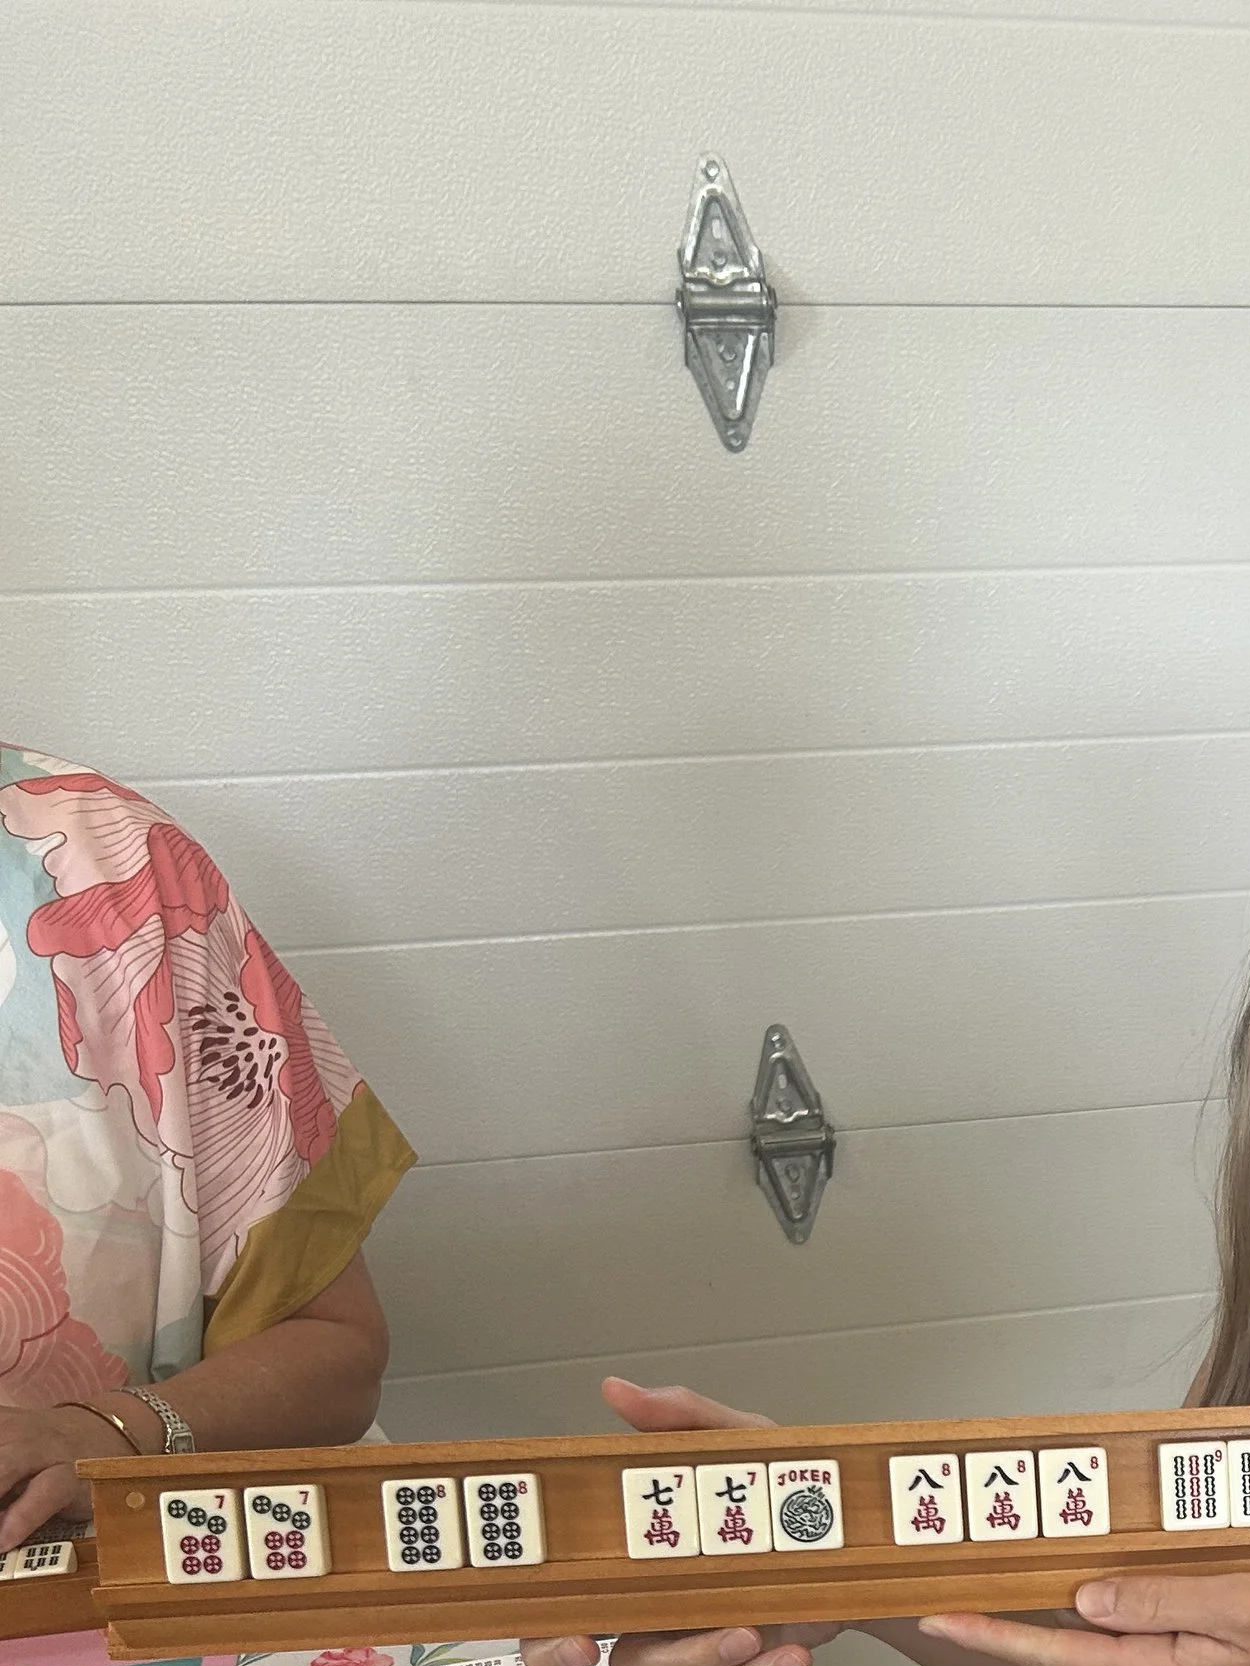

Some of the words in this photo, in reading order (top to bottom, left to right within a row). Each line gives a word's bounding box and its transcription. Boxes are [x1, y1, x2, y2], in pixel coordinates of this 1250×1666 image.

[1090, 1456, 1099, 1469] 8
[1214, 1450, 1222, 1462] 9
[942, 1463, 951, 1476] 8
[1017, 1460, 1026, 1473] 8
[674, 1474, 683, 1488] 7
[747, 1472, 757, 1485] 7
[777, 1469, 832, 1486] JOKER
[437, 1484, 446, 1498] 8
[518, 1481, 528, 1494] 8
[214, 1495, 225, 1509] 7
[299, 1491, 310, 1504] 7
